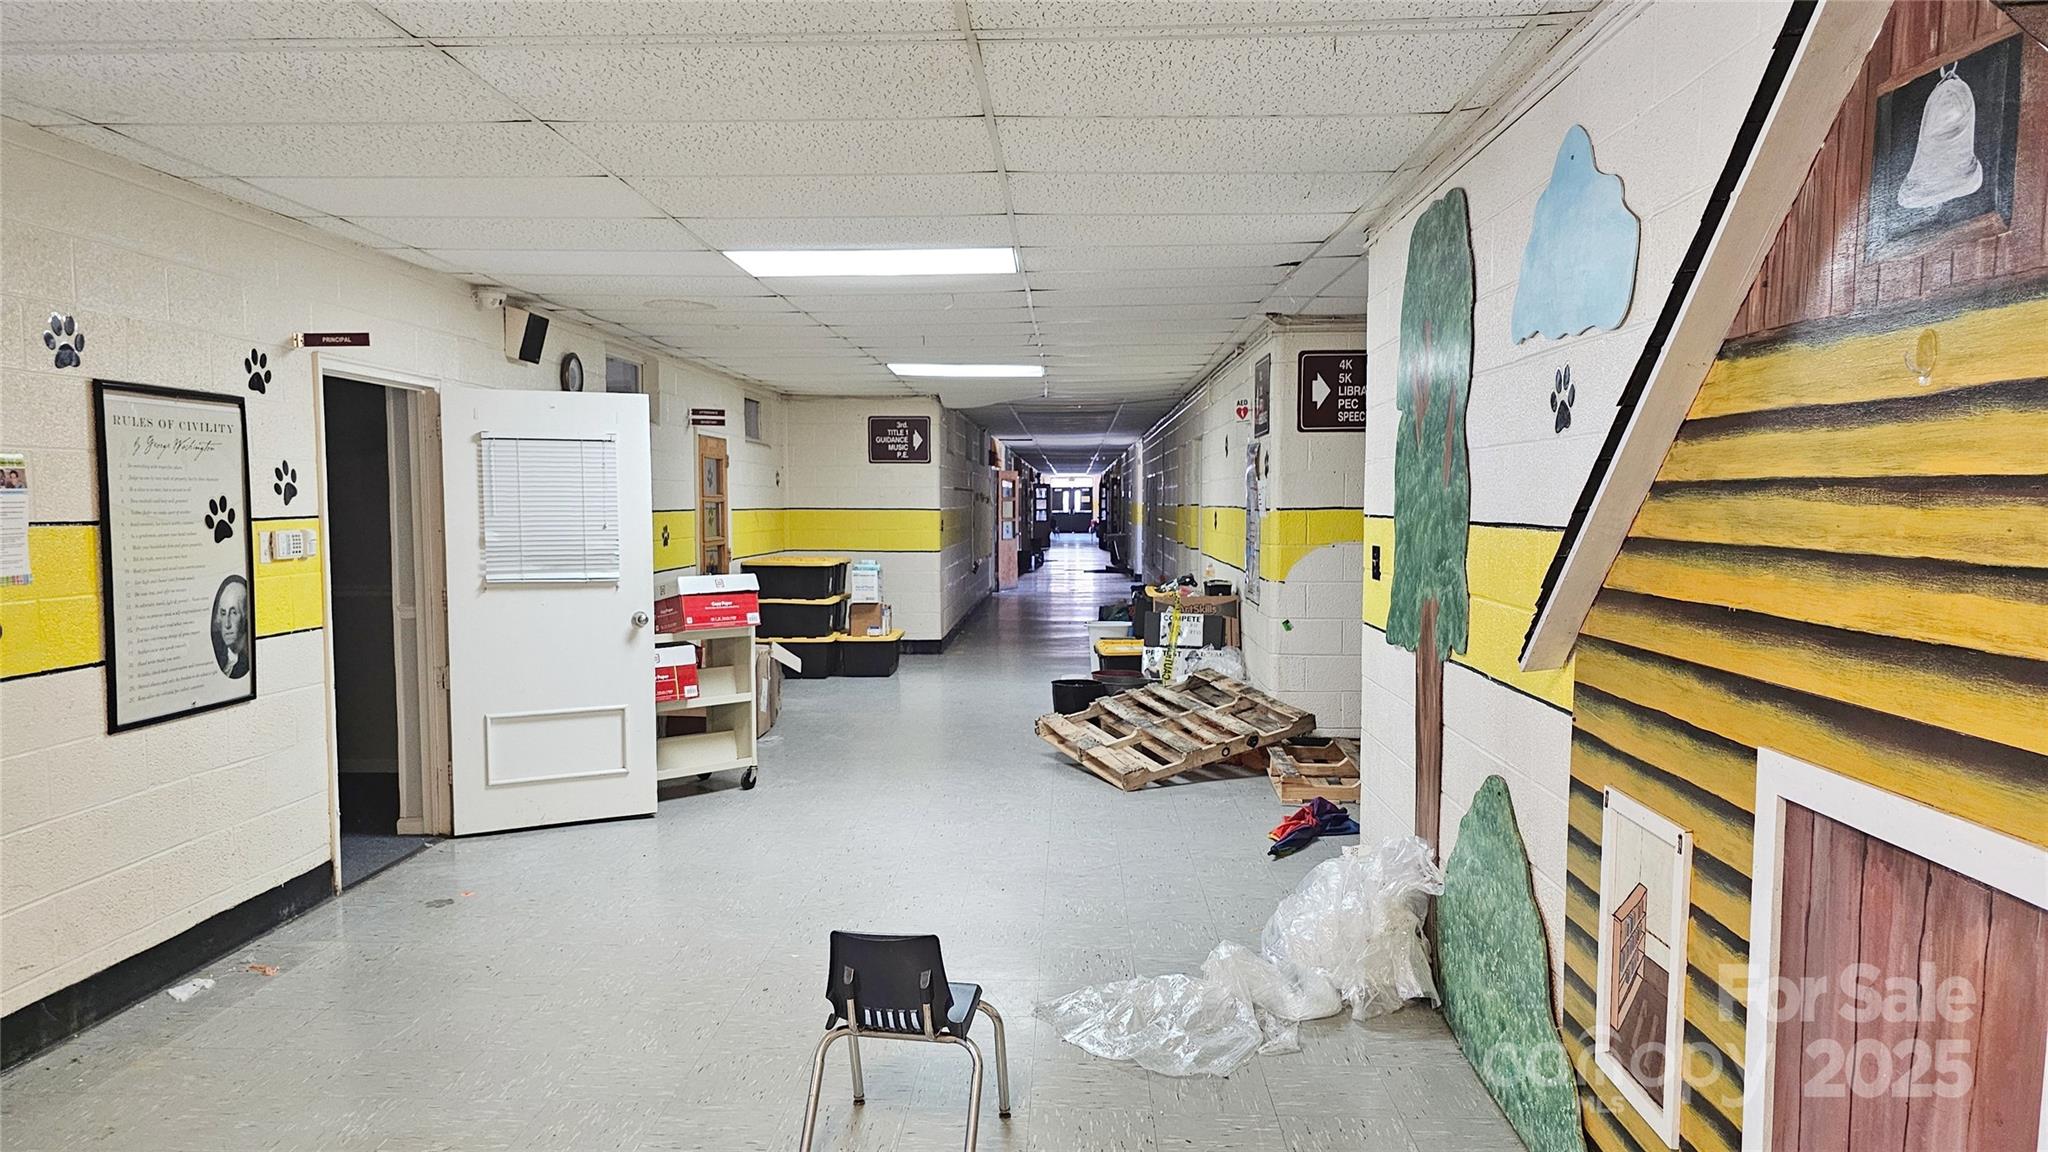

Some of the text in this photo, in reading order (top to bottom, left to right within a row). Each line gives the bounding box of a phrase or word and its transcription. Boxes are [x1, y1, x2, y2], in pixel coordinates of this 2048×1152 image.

[1339, 359, 1353, 370] 4K
[1338, 373, 1352, 384] 5K
[1338, 398, 1359, 409] PEC
[1337, 411, 1366, 422] SPEEC
[113, 414, 235, 434] RULES OF CIVILITY
[144, 434, 171, 460] George
[173, 436, 222, 461] Washington
[1163, 614, 1200, 622] COPETE
